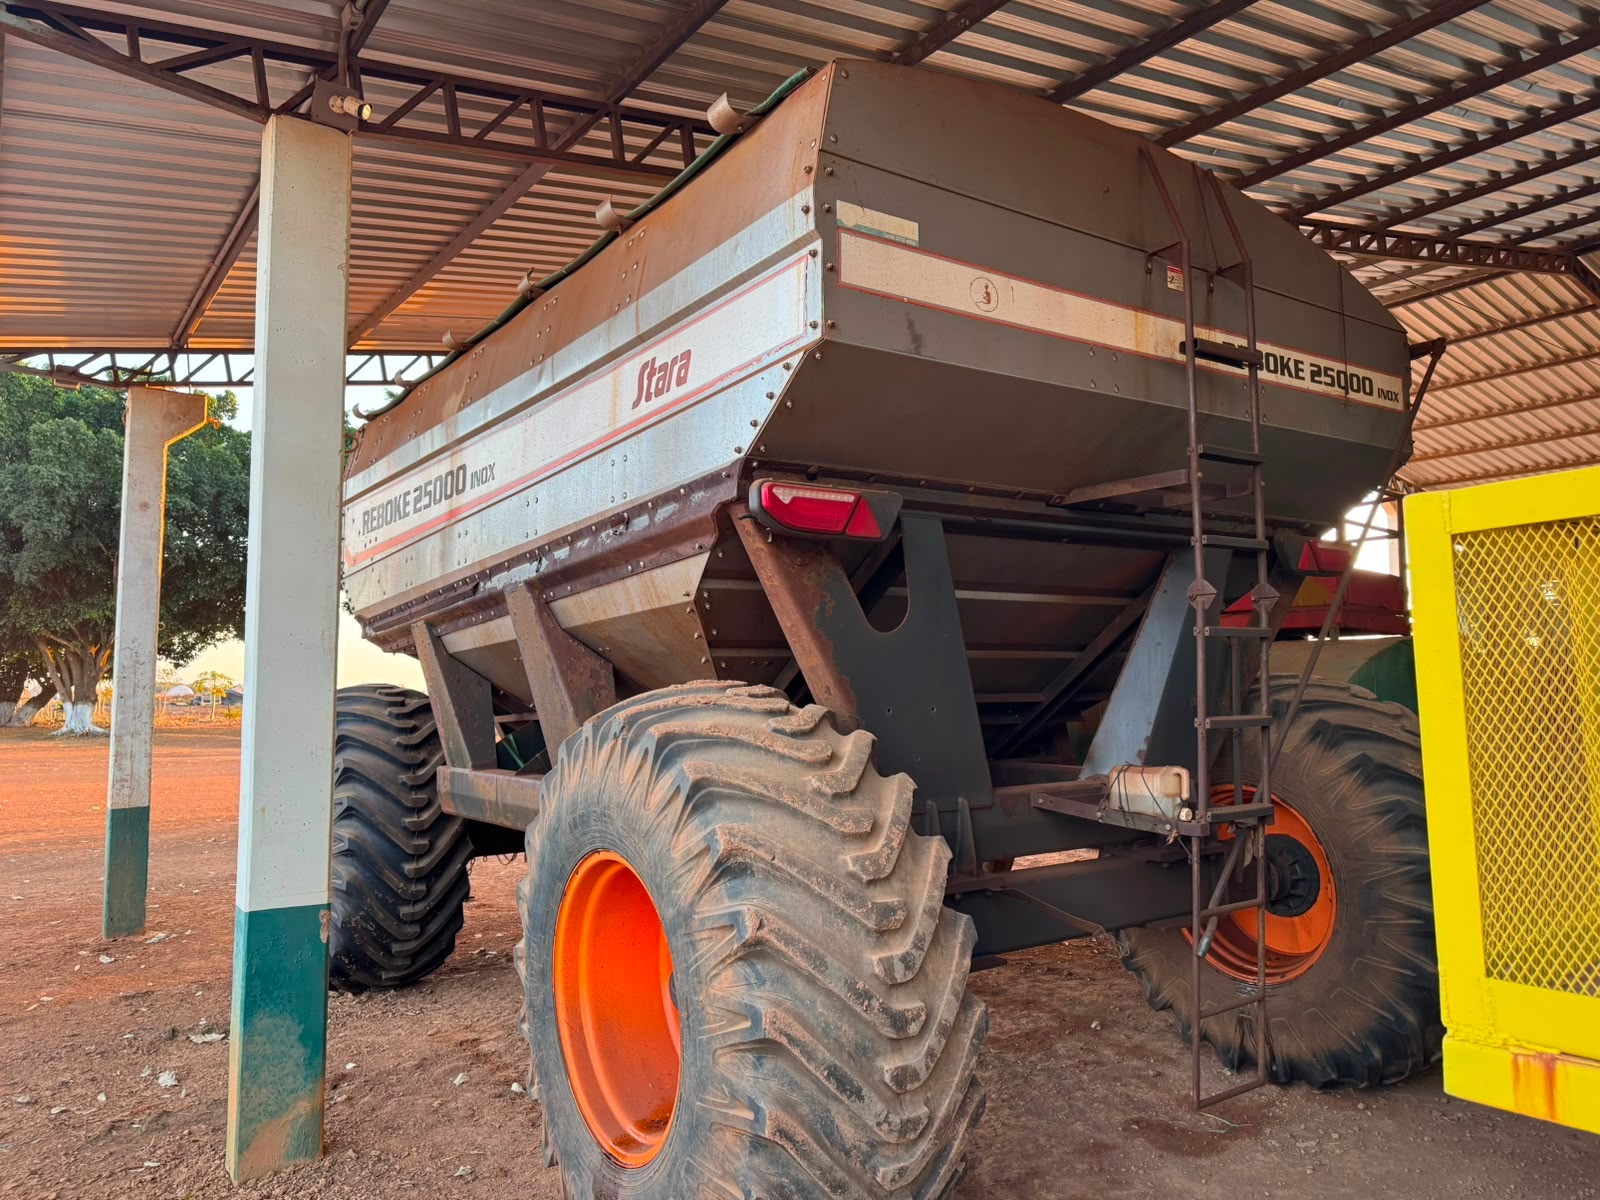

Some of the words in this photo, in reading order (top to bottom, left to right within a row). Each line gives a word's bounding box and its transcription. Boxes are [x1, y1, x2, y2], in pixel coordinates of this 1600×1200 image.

[631, 349, 692, 410] Stara
[1222, 341, 1306, 381] OKE
[1310, 363, 1374, 397] 25000
[1377, 387, 1400, 404] INOX
[362, 489, 411, 536] REBOKE
[412, 464, 467, 514] 25000
[470, 462, 496, 490] INOX
